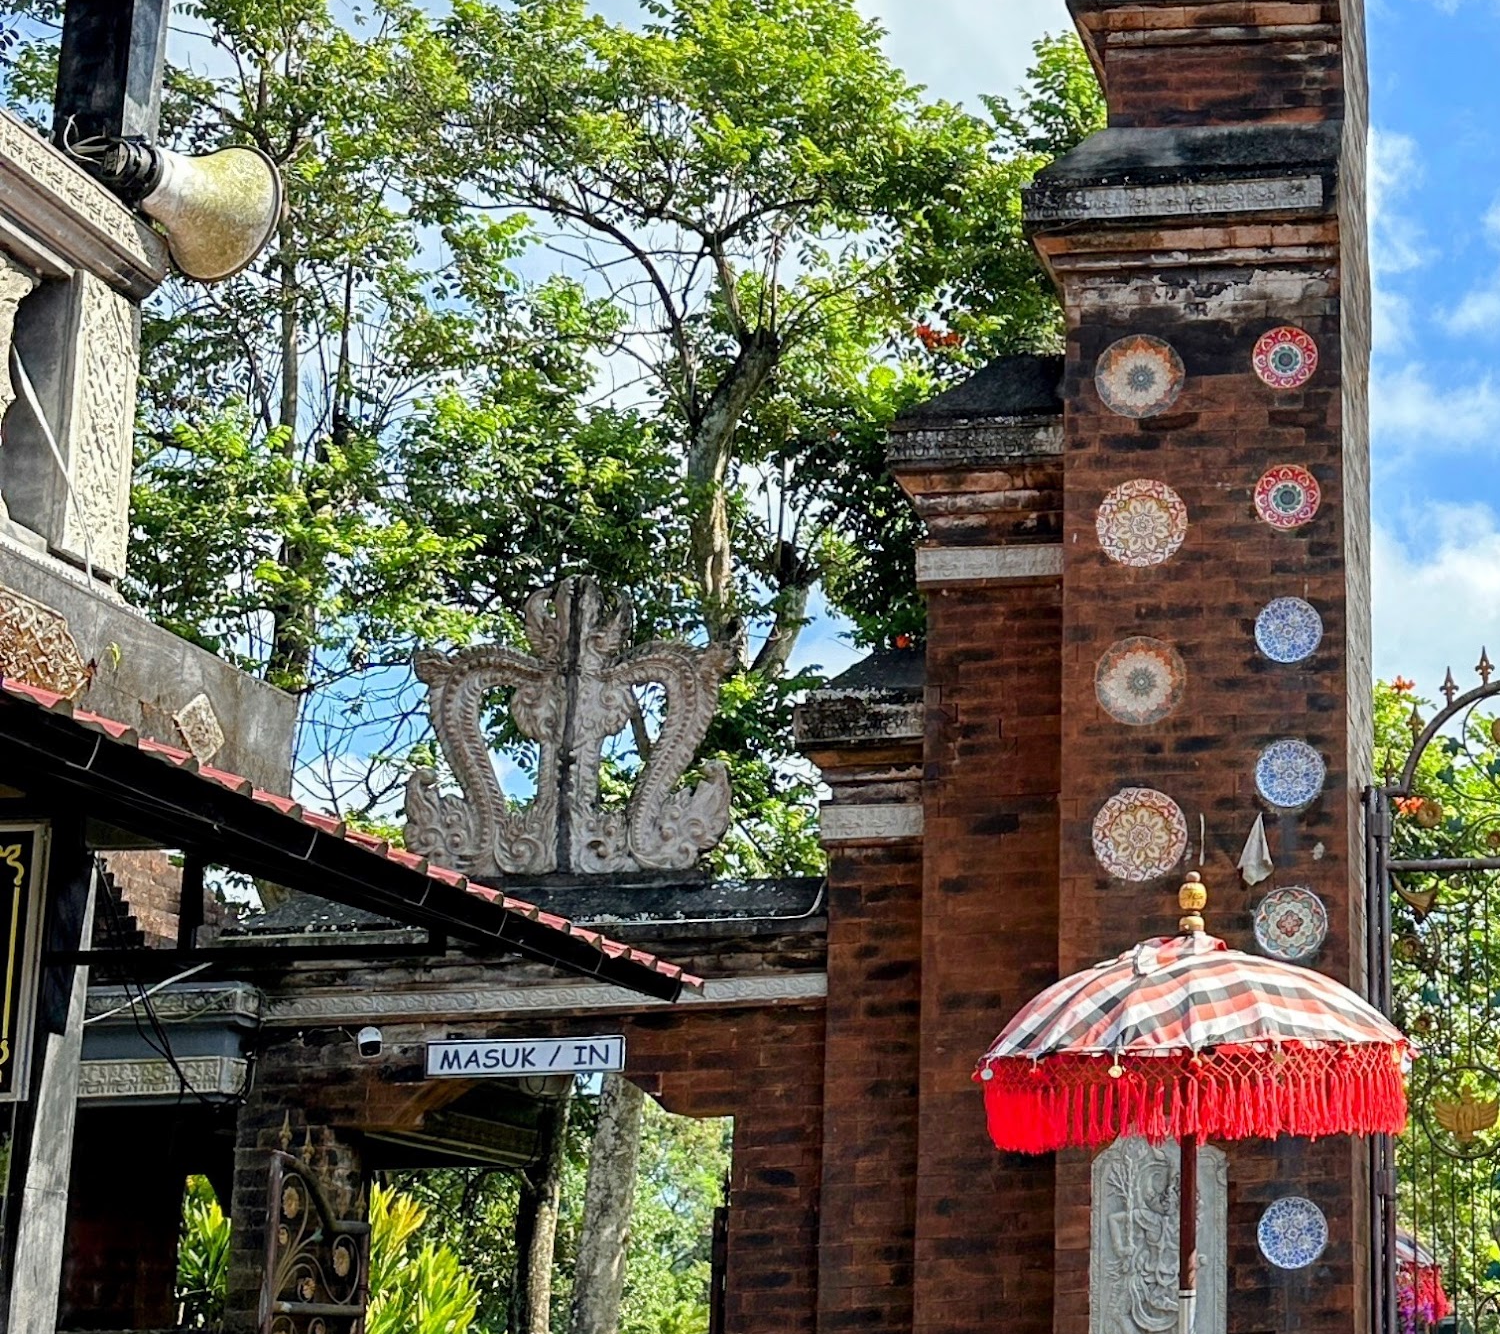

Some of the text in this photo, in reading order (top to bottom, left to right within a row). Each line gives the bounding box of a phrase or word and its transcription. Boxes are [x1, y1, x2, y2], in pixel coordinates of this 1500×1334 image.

[439, 1044, 609, 1070] MASUK / IN
